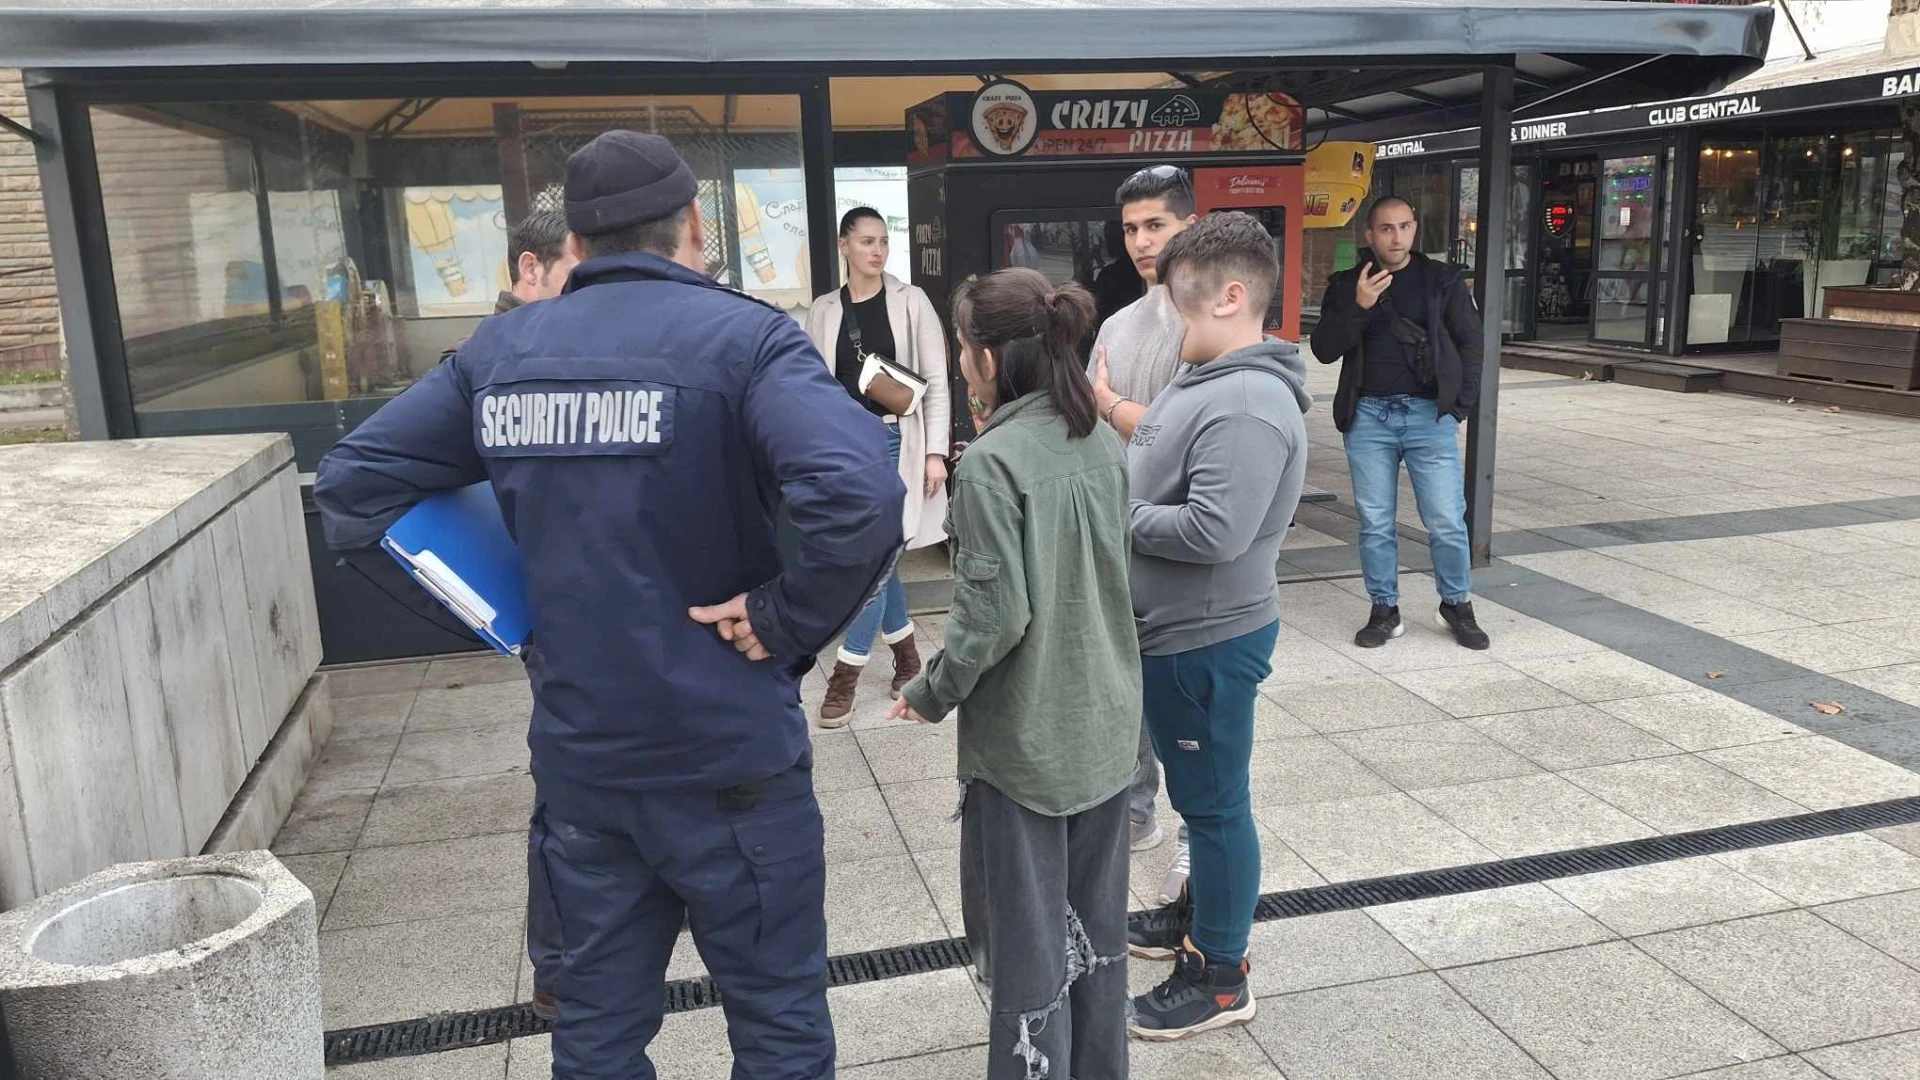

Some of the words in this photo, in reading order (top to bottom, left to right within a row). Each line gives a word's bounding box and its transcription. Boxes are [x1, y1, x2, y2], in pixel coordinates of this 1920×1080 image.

[1051, 99, 1149, 129] CRAZY
[1648, 106, 1686, 125] CLUB
[1689, 96, 1761, 121] CENTRAL
[1128, 129, 1193, 152] PIZZA
[1520, 121, 1567, 140] DINNER
[1035, 139, 1074, 152] OPEN
[1077, 138, 1107, 152] 24/7
[1387, 140, 1425, 156] CENTRAL
[921, 246, 942, 277] PIZZA
[481, 392, 583, 448] SECURITY
[584, 389, 663, 444] POLICE
